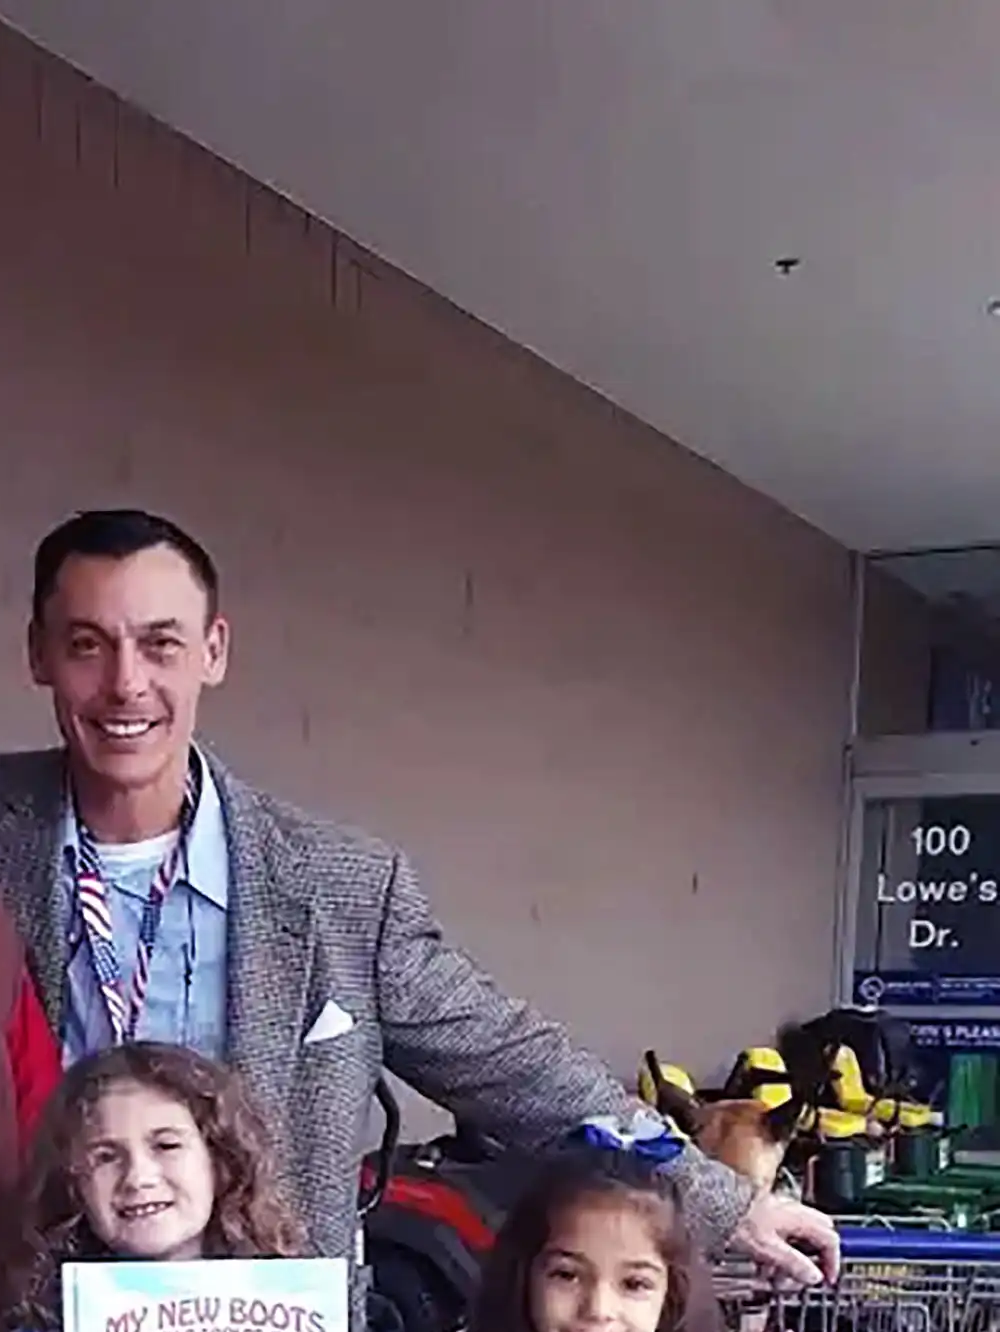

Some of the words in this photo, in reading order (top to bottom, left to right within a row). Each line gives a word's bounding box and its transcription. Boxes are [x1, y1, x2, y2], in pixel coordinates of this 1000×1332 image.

[911, 825, 971, 856] 100
[877, 873, 998, 903] Lowe's
[909, 920, 960, 949] Dr.
[158, 1297, 220, 1330] NEW
